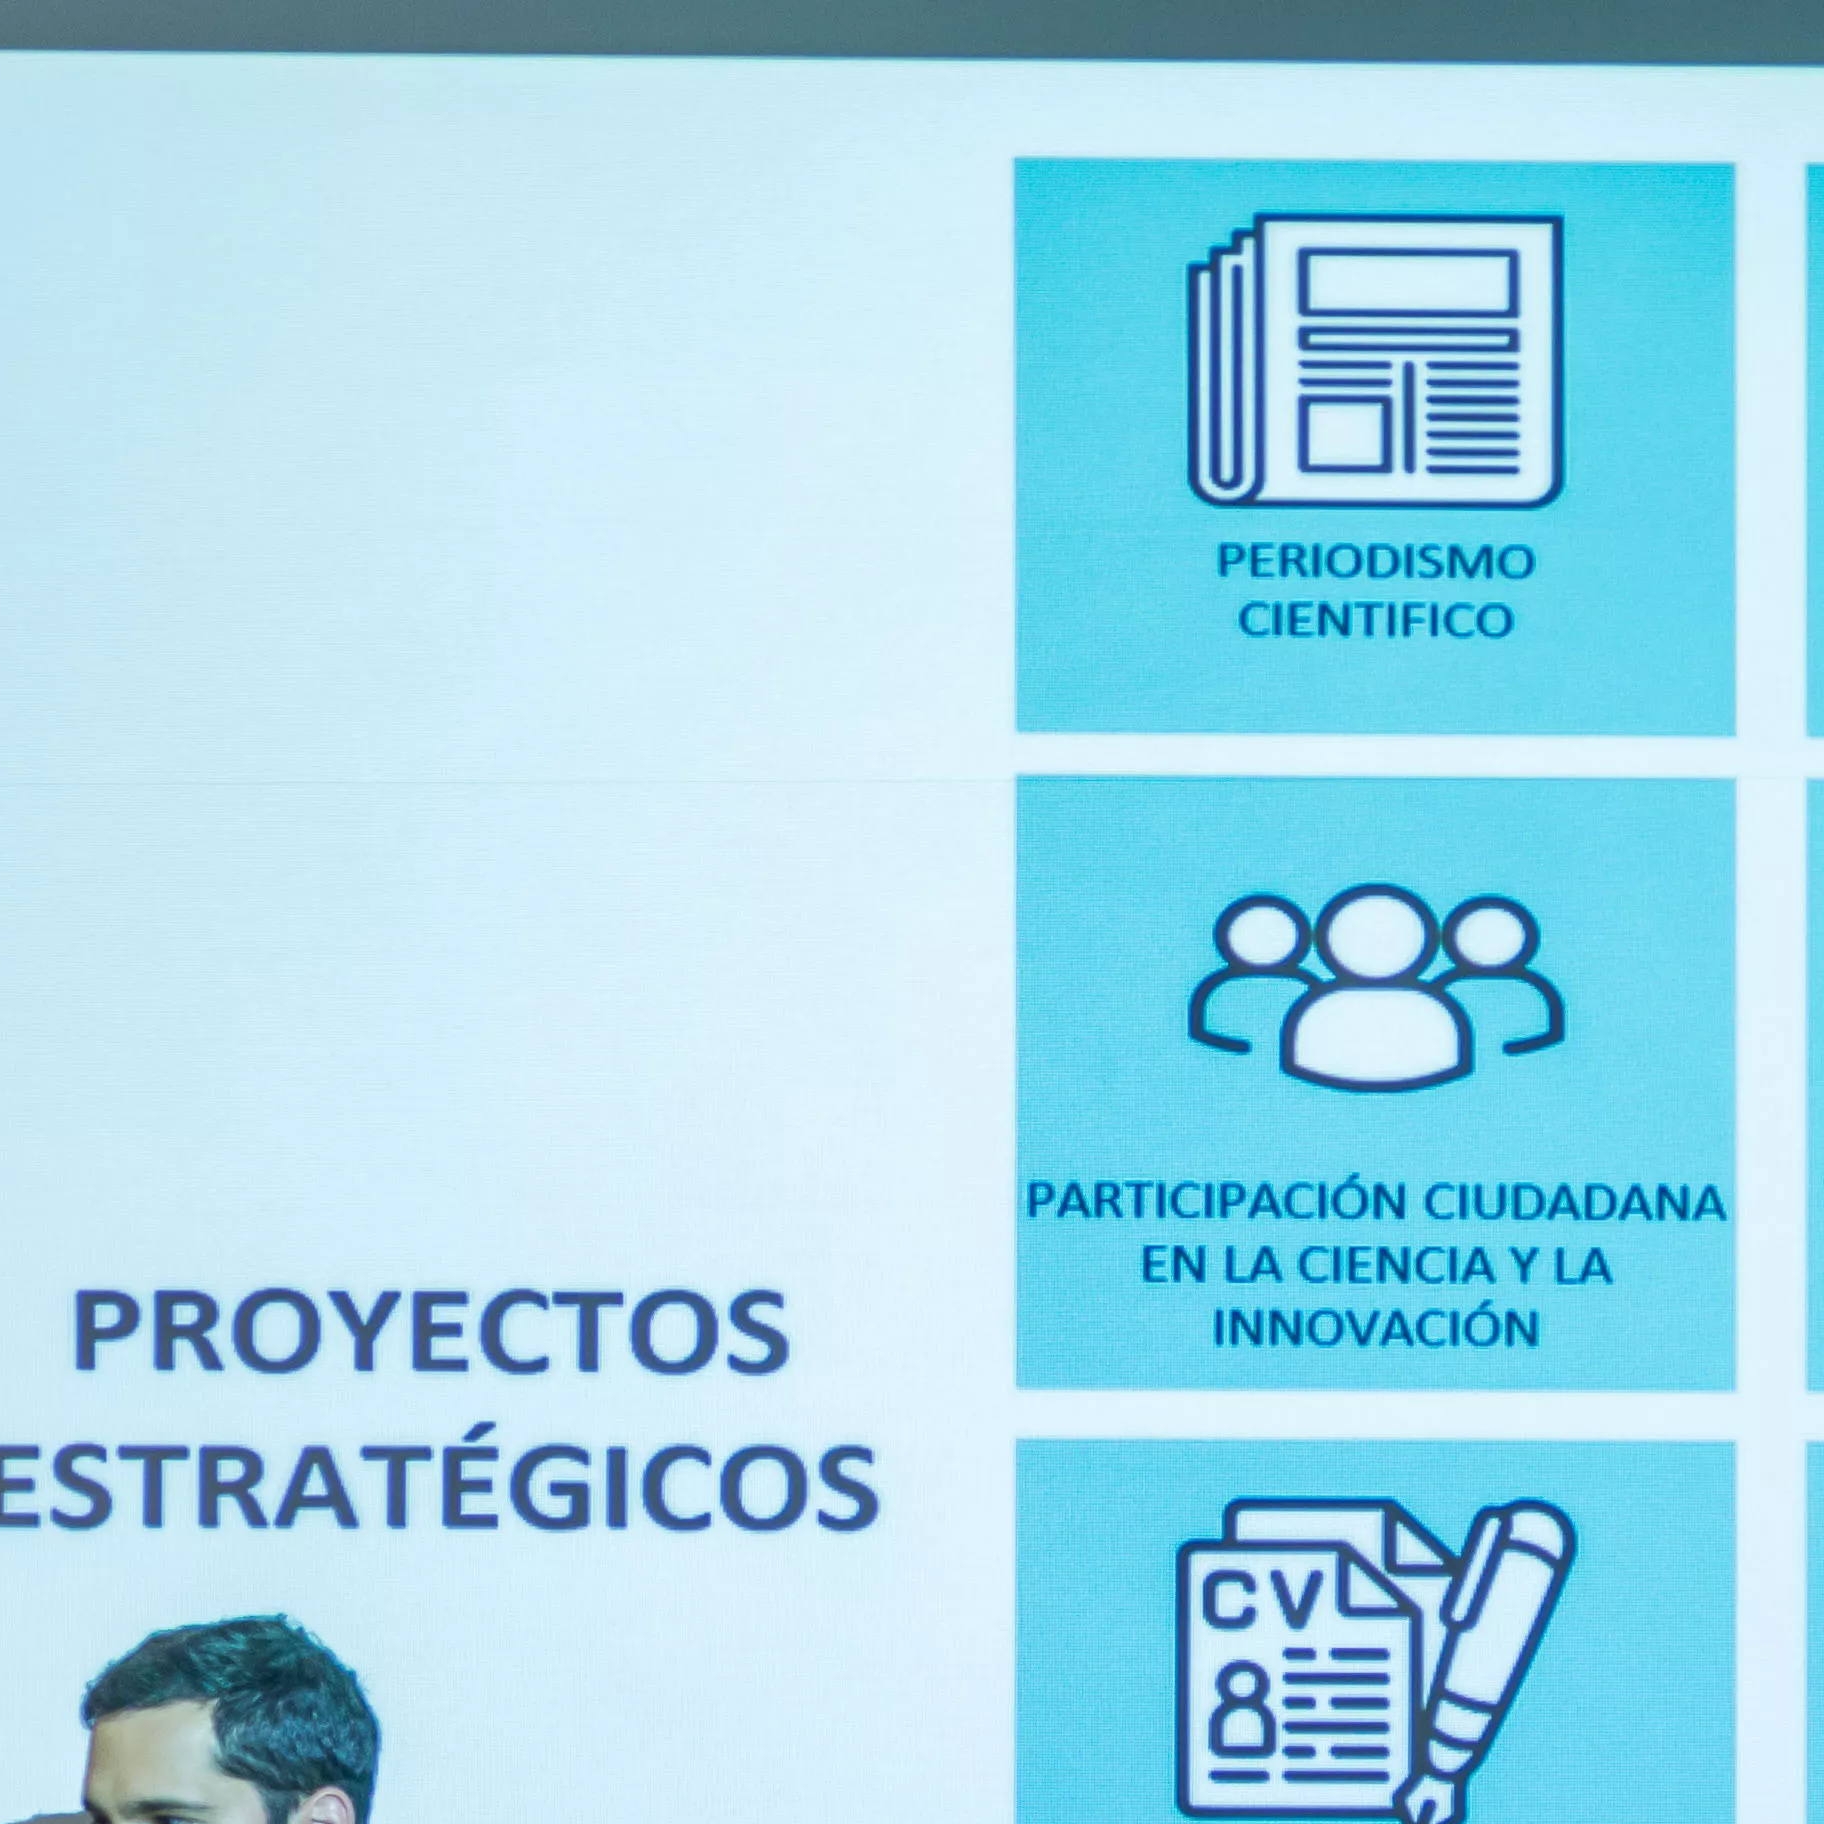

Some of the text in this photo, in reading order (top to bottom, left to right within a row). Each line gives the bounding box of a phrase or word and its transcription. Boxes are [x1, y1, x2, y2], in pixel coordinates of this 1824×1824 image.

[1220, 543, 1535, 579] PERIODISMO
[1239, 602, 1513, 638] CIENTIFICO
[1028, 1173, 1726, 1221] PARTICIPACIÓN CIUDADANA
[1143, 1245, 1613, 1285] EN LA CIENCIA Y LA
[75, 1287, 790, 1376] PROYECTOS
[1214, 1299, 1538, 1347] INNOVACIÓN
[1203, 1569, 1323, 1630] CV
